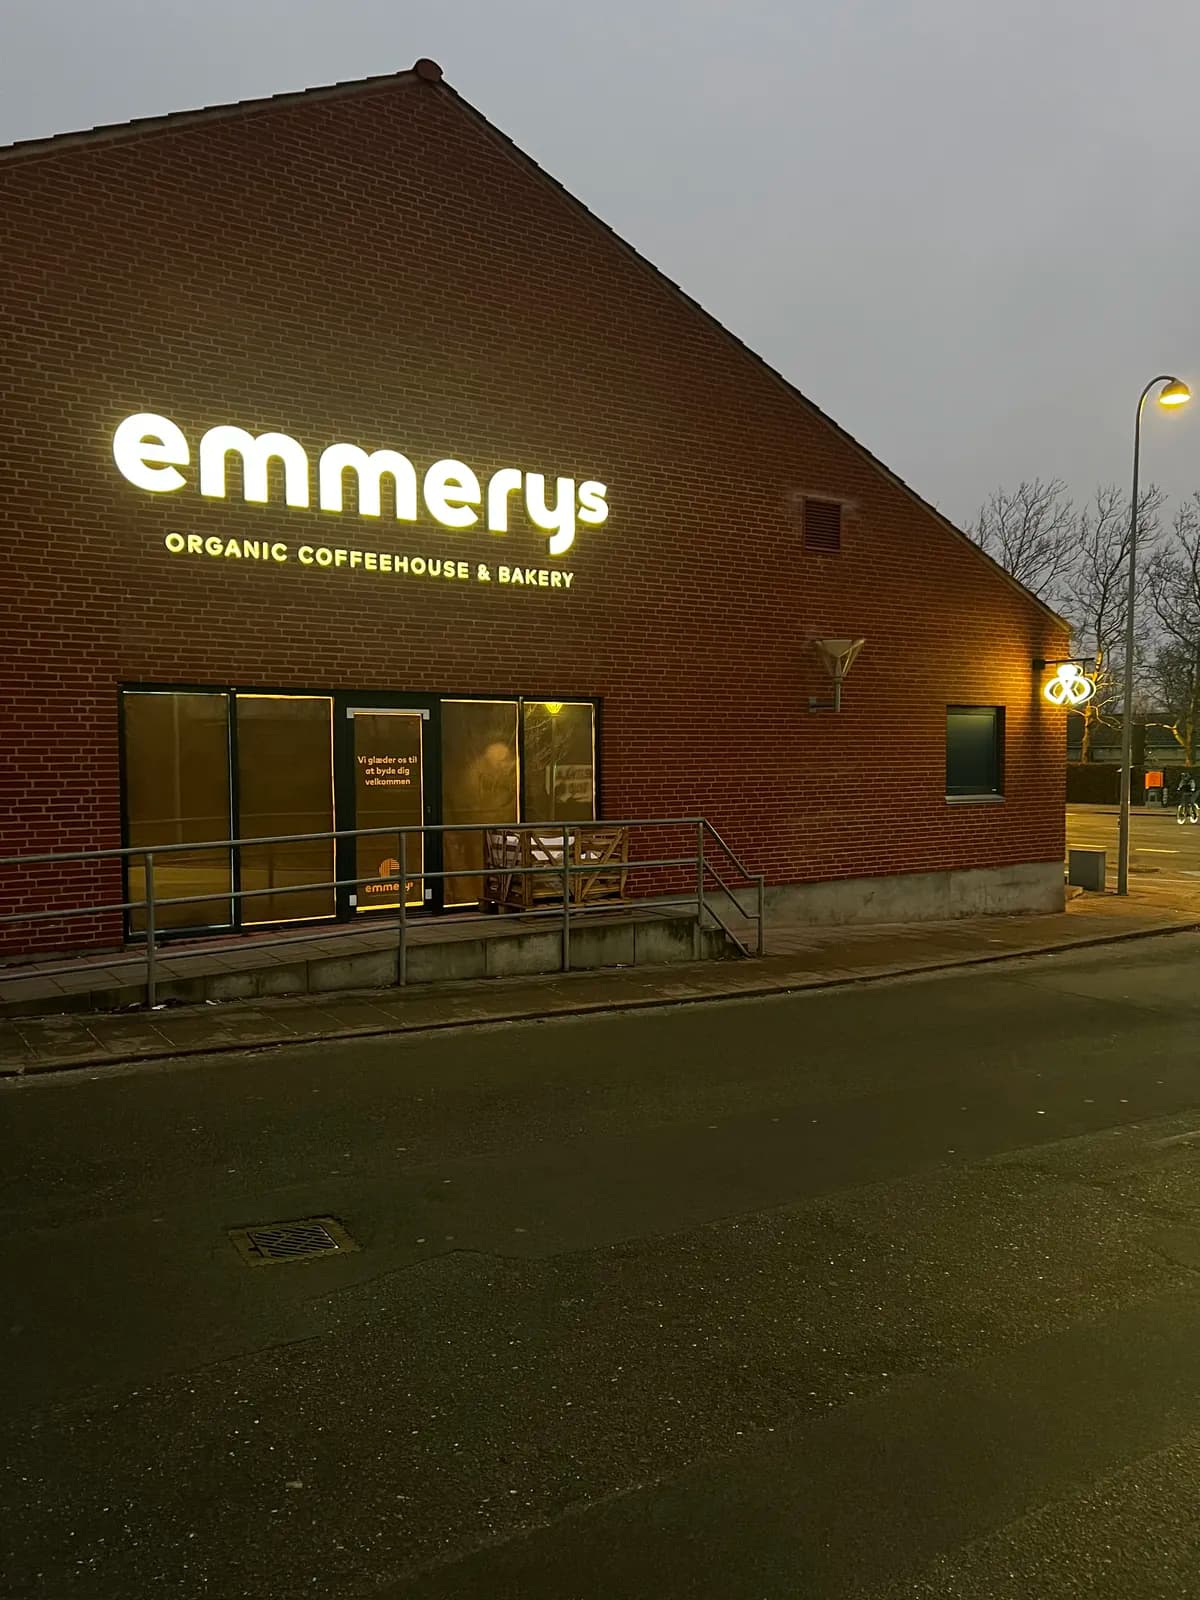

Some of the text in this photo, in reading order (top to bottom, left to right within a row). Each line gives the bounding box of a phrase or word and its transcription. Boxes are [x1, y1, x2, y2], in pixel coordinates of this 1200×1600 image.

[112, 412, 609, 556] emmerys
[165, 532, 574, 588] ORGANIC COFFEEHOUSE & BAKERY
[357, 755, 367, 764] Vi
[367, 755, 397, 766] glæder
[408, 755, 418, 764] til
[365, 766, 410, 777] at byde dig
[364, 777, 411, 786] velkommen
[365, 881, 414, 893] emmeys
